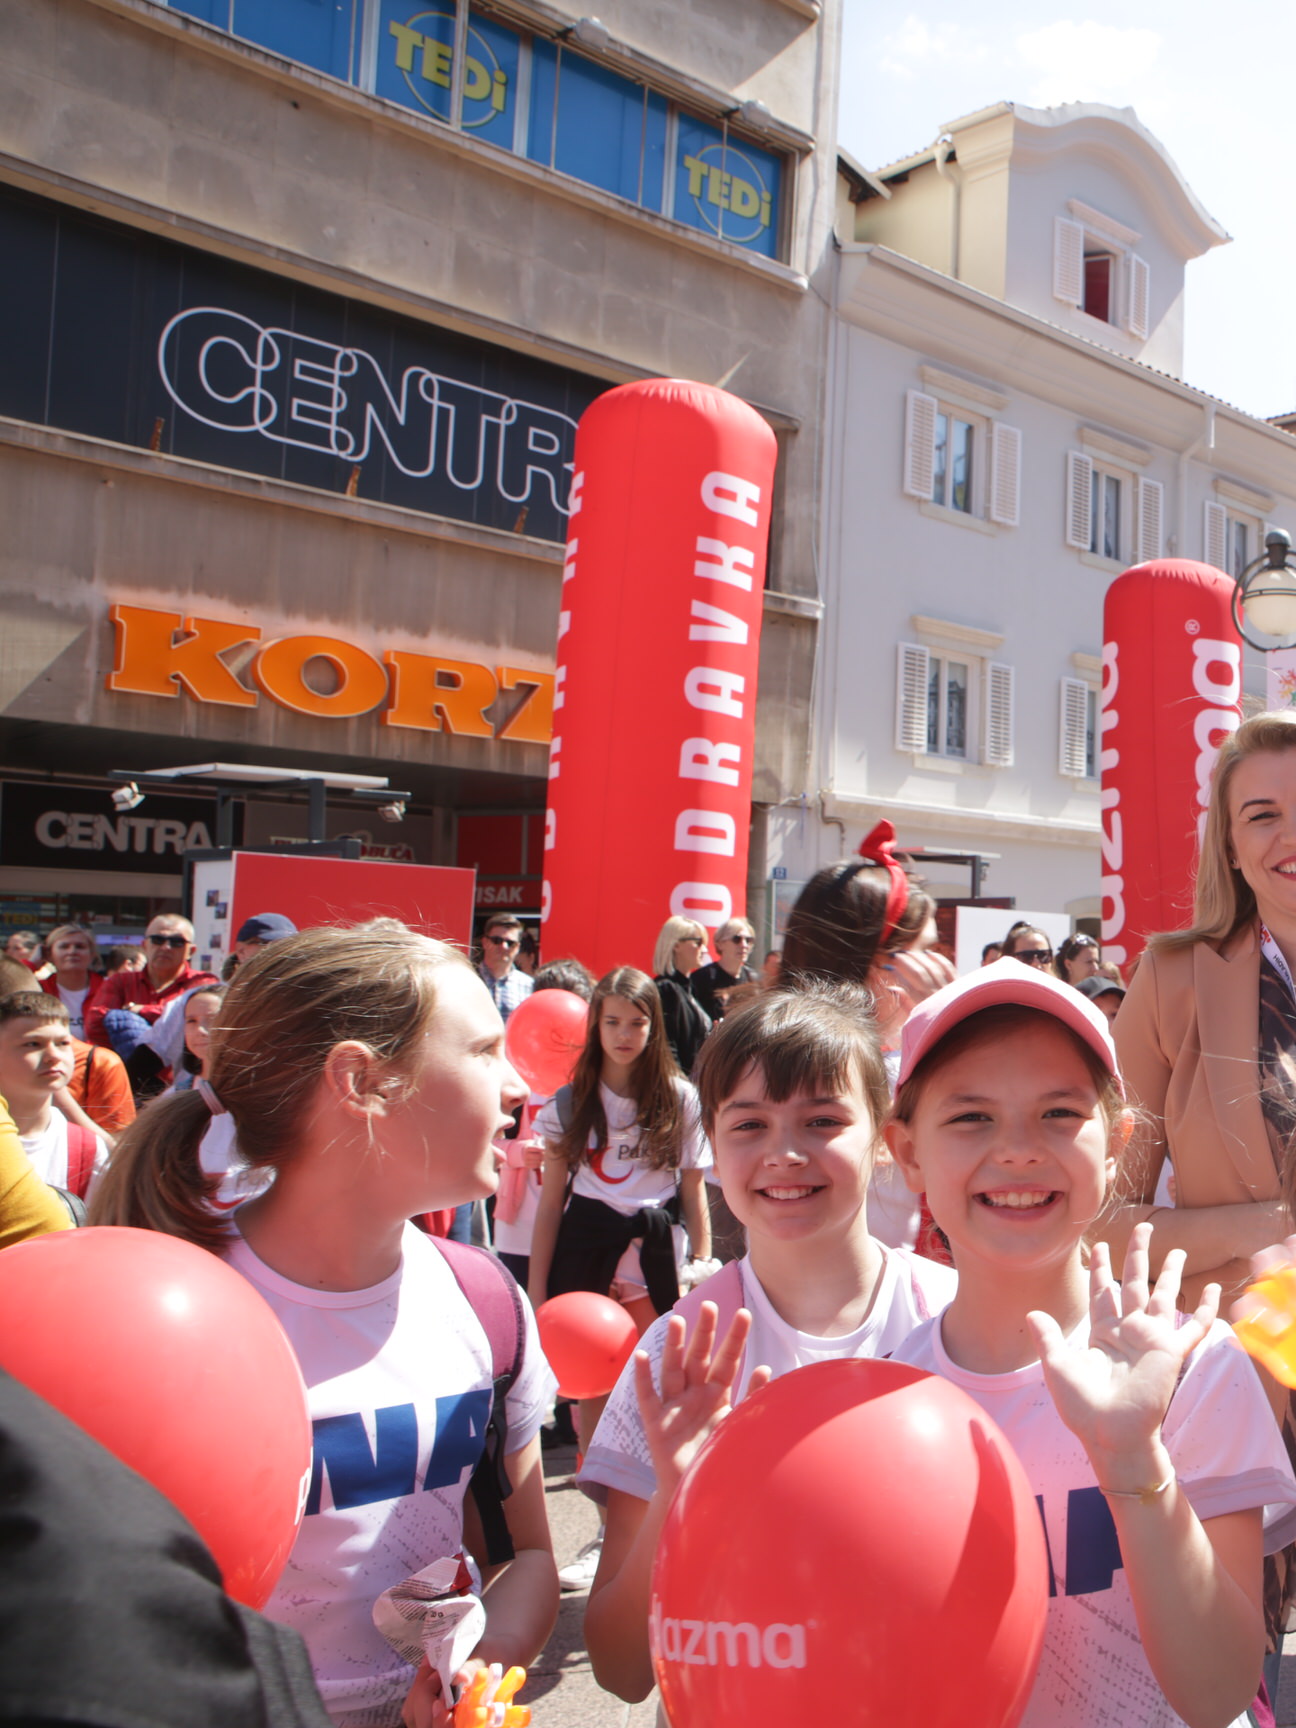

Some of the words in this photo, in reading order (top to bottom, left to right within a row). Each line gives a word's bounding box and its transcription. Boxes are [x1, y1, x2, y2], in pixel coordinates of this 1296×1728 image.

[389, 20, 506, 112] TEDi
[684, 155, 772, 227] TEDi
[158, 307, 578, 516] CENTR
[669, 471, 760, 966] ODRAVKA
[35, 811, 214, 854] CENTRA
[648, 1594, 807, 1669] lazma
